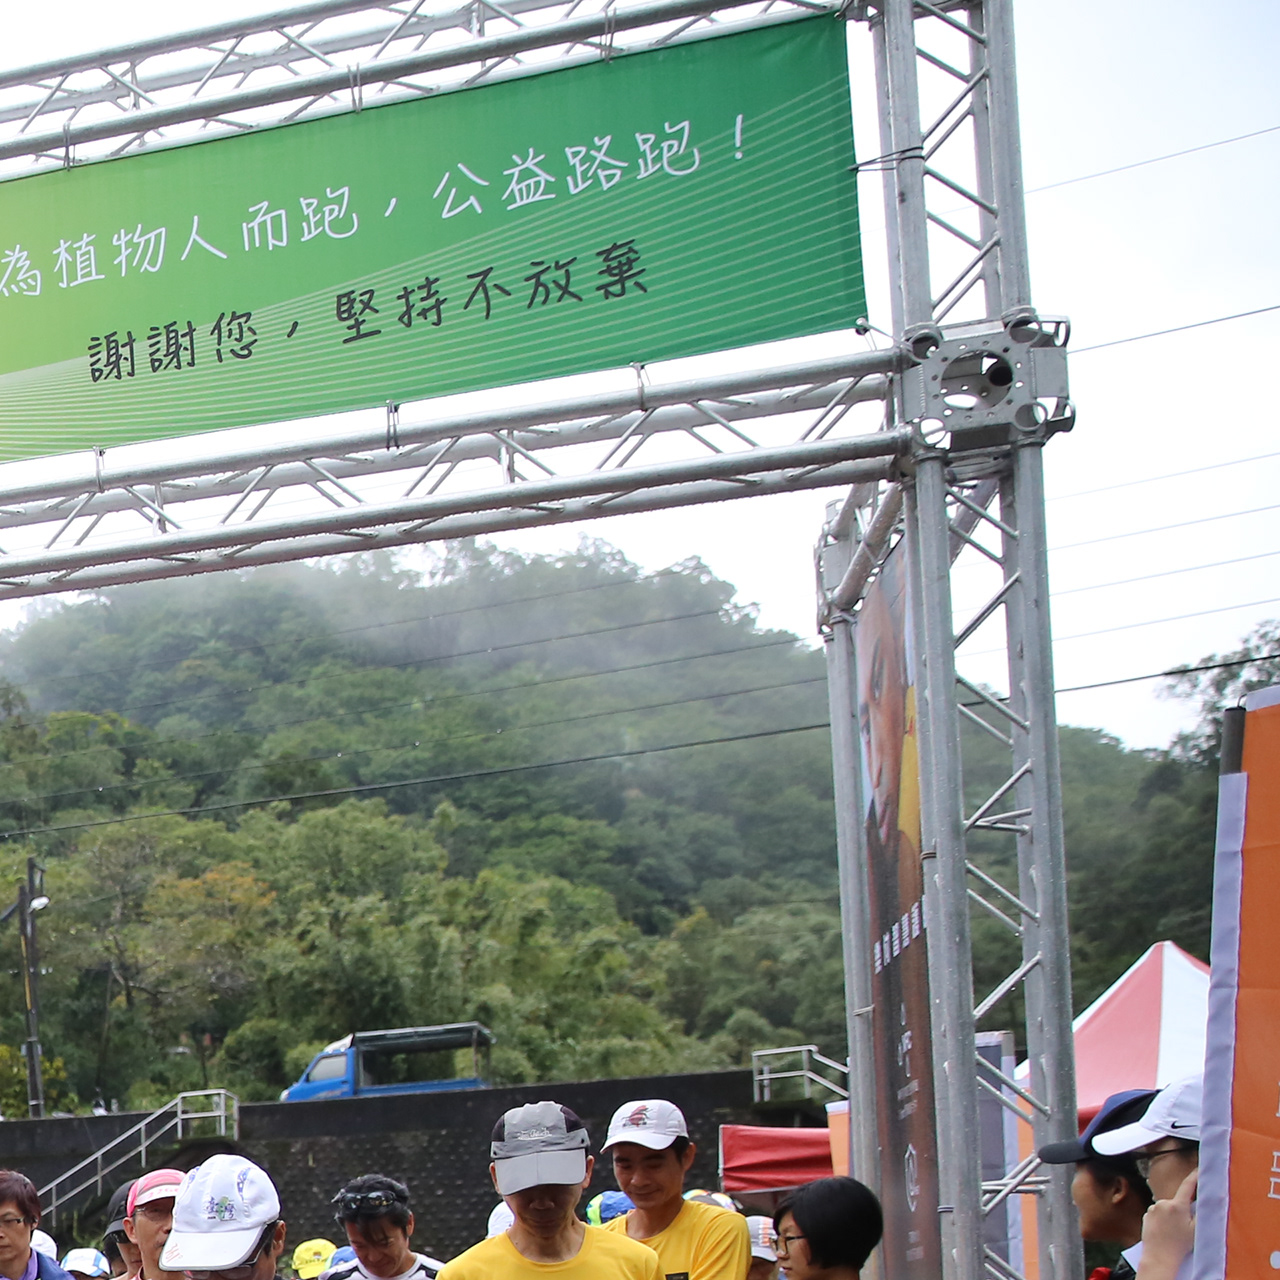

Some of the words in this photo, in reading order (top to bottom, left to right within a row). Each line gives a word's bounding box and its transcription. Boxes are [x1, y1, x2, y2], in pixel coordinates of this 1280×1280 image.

[88, 238, 648, 384] 謝謝您，堅持不放棄
